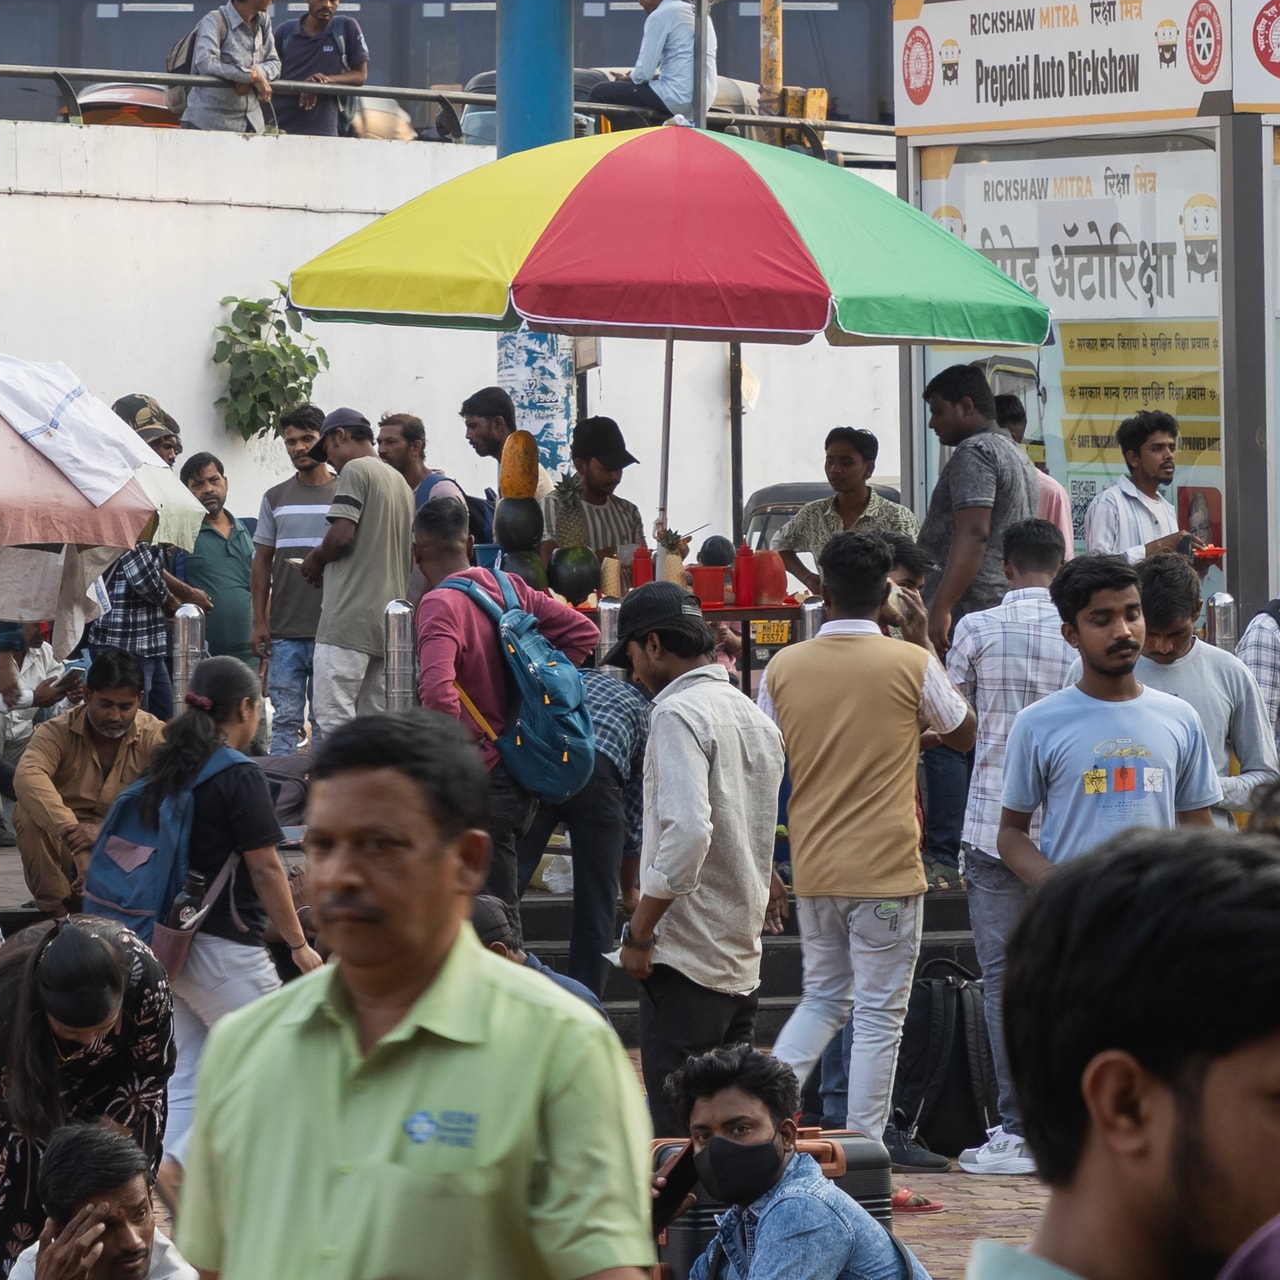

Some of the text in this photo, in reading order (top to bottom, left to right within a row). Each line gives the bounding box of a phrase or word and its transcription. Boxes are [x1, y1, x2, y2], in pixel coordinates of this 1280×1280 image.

[970, 8, 1035, 36] RICKSHAW
[1040, 4, 1080, 30] MITRA
[976, 55, 1030, 107] Prepaid
[1033, 54, 1065, 99] Auto
[1068, 48, 1139, 97] Rickshaw
[983, 165, 1157, 202] RICKSHAW MITRA रिक्षा मित्र
[1077, 338, 1098, 350] सरकार
[1100, 337, 1114, 350] मान्य
[1117, 333, 1140, 350] किराया
[1150, 333, 1172, 356] सुरक्षित
[1175, 332, 1189, 351] रिक्षा
[1191, 337, 1210, 350] प्रवास
[1079, 381, 1206, 406] सरकार मान्य दरात सुरक्षित रिक्षा प्रवास
